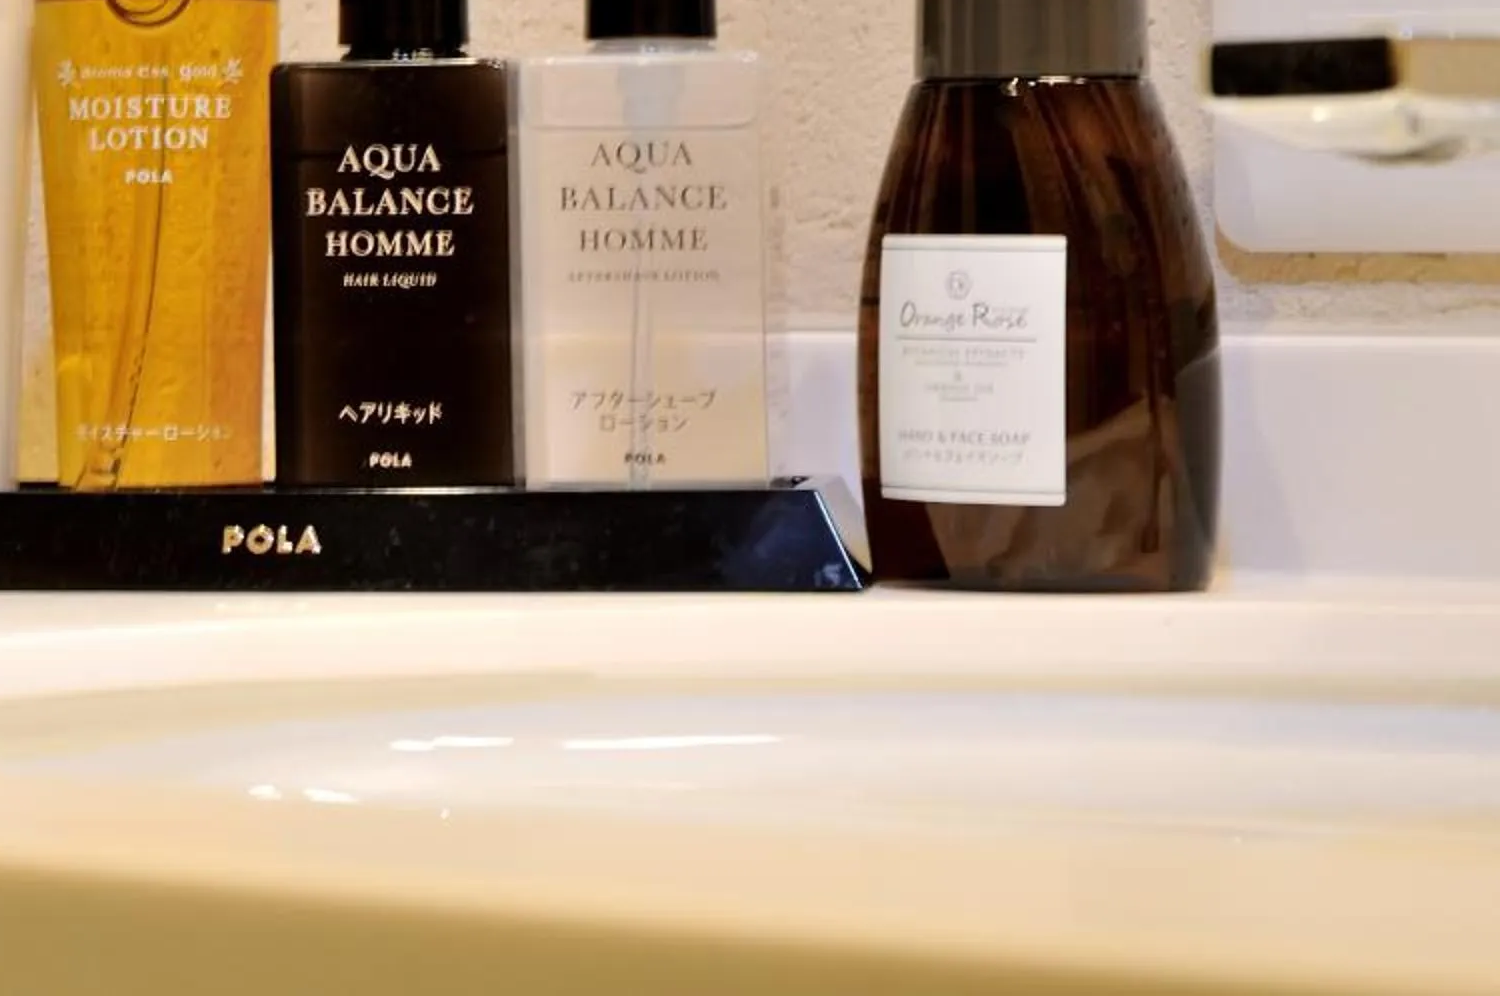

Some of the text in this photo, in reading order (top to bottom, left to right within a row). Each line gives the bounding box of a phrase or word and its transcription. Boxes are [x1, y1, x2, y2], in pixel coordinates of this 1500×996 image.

[68, 93, 232, 121] MOISTURE
[88, 124, 209, 152] LOTION
[337, 143, 443, 180] AQUA
[590, 139, 693, 175] AQUA
[124, 168, 174, 185] POLA
[304, 186, 475, 217] BALANCE
[560, 184, 728, 212] BALANCE
[324, 229, 456, 257] HOMME
[580, 227, 709, 252] HOMME
[343, 271, 438, 289] HAIR LIQUID
[900, 300, 967, 333] Orange
[338, 400, 443, 425] ヘアリキッド
[570, 388, 717, 410] アフターシェーブ
[600, 414, 689, 433] ローション
[368, 452, 412, 468] POLA
[623, 453, 666, 465] POLA
[221, 523, 322, 555] POLA
